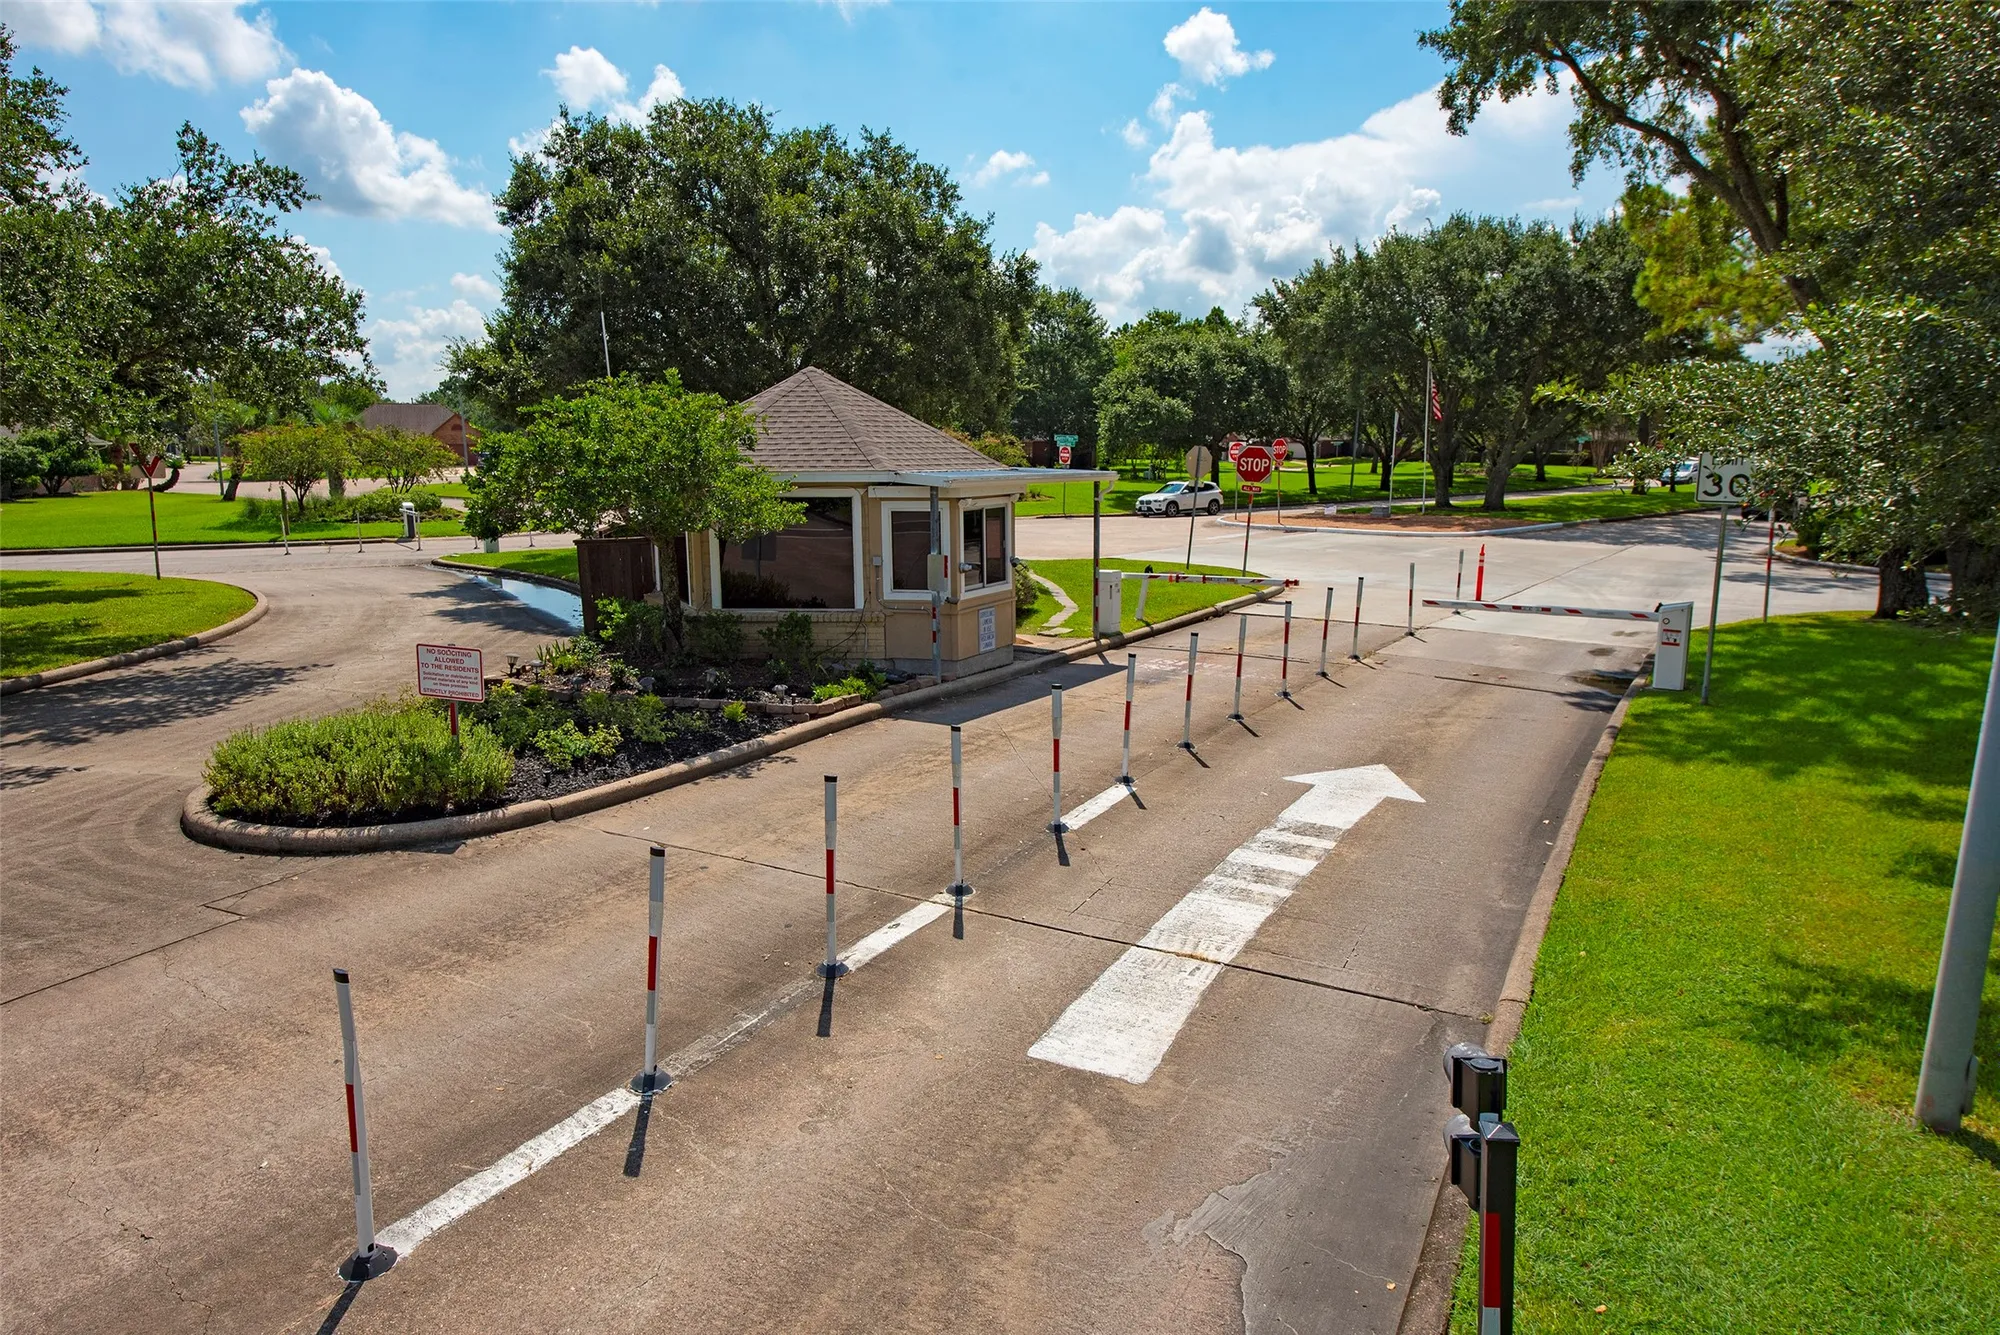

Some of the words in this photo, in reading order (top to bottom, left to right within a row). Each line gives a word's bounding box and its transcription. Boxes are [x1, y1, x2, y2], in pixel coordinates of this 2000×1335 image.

[1273, 445, 1286, 454] STOP
[1240, 458, 1270, 472] STOP
[1702, 473, 1750, 497] 30
[437, 649, 472, 658] SOLICITING
[444, 665, 479, 673] RESIDENTS
